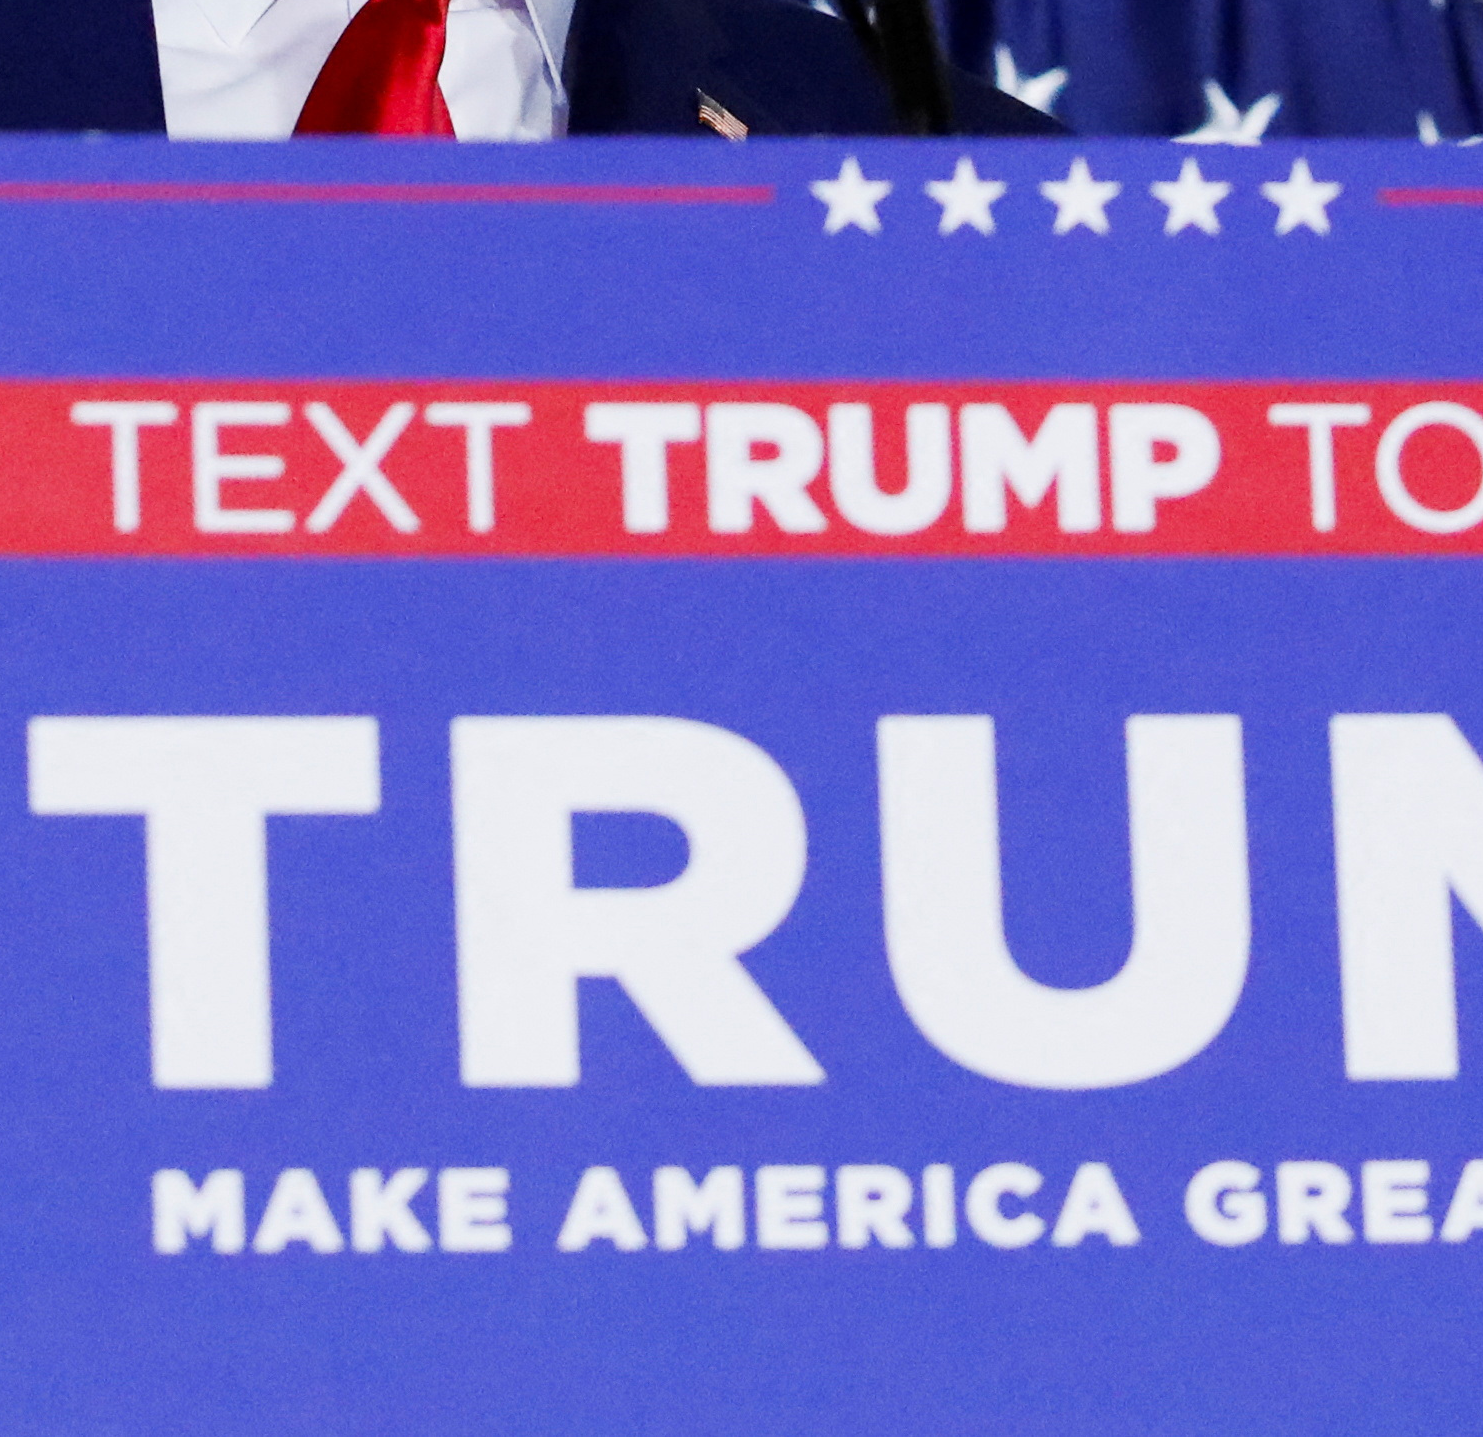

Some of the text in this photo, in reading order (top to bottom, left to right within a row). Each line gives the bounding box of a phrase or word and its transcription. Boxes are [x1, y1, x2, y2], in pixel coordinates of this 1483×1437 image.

[70, 400, 532, 534] TEXT
[584, 401, 1222, 536] TRUMP
[151, 1166, 513, 1255] MAKE
[556, 1161, 1142, 1253] AMERICA
